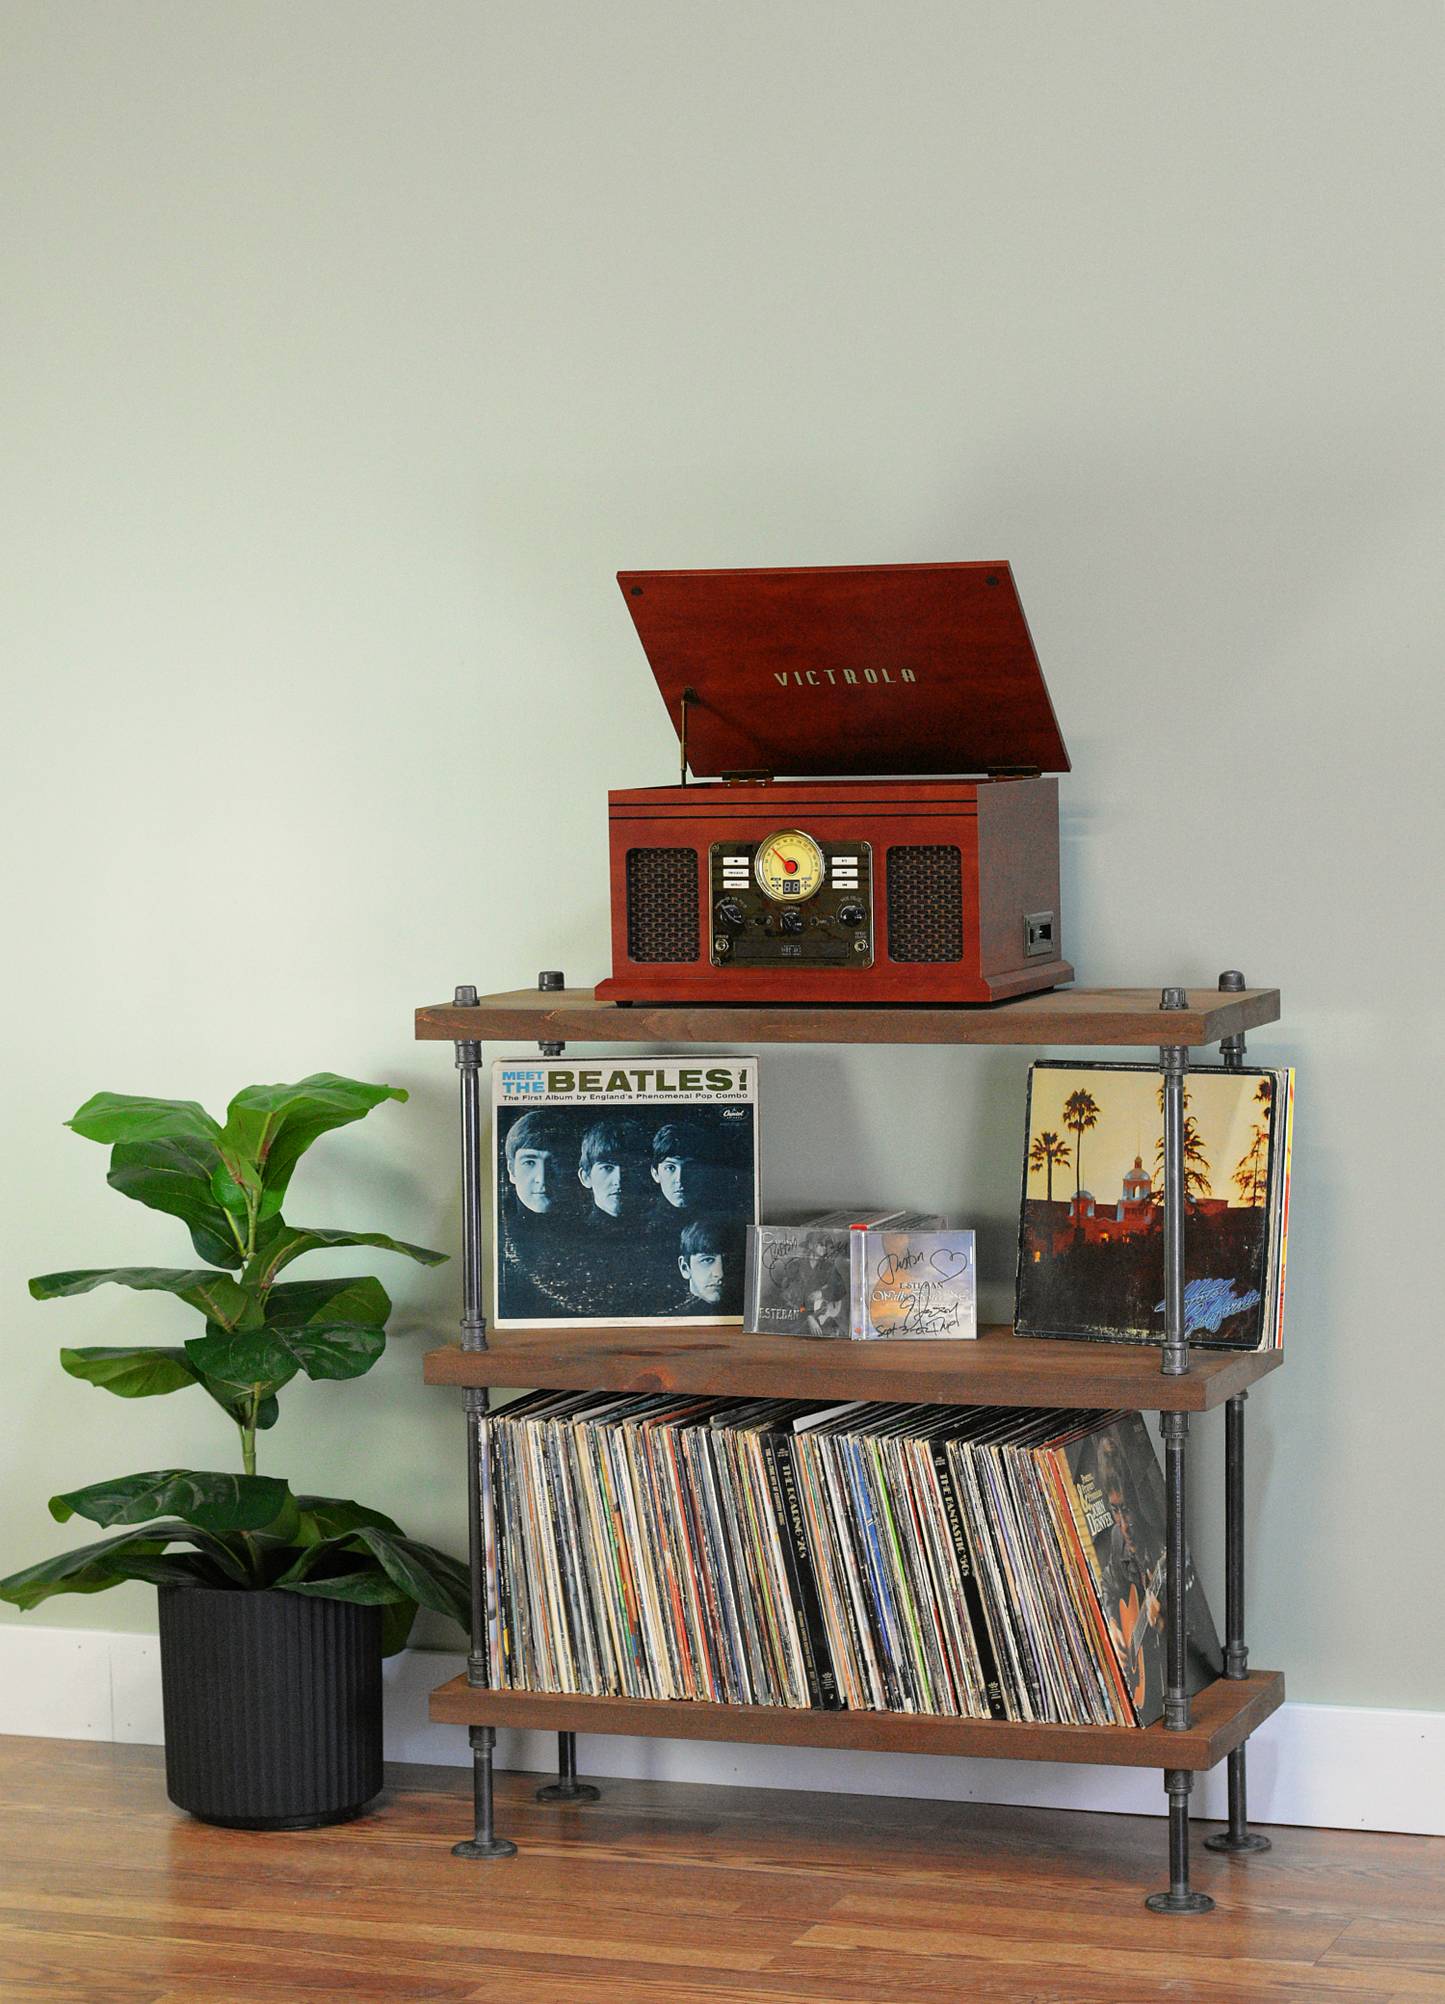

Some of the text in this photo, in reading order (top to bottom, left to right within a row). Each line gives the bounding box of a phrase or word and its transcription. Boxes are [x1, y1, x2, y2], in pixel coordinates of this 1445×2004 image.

[774, 668, 916, 686] VICTROLA
[502, 1071, 545, 1081] MEET
[502, 1069, 747, 1094] THE BEATLES!
[759, 1307, 800, 1319] ESTEBAN
[782, 1464, 794, 1486] THE
[939, 1472, 952, 1495] THE
[786, 1487, 804, 1537] ROARING
[1091, 1499, 1107, 1519] JOHN
[945, 1496, 966, 1554] FANTASTIC
[1085, 1511, 1115, 1537] DENVER
